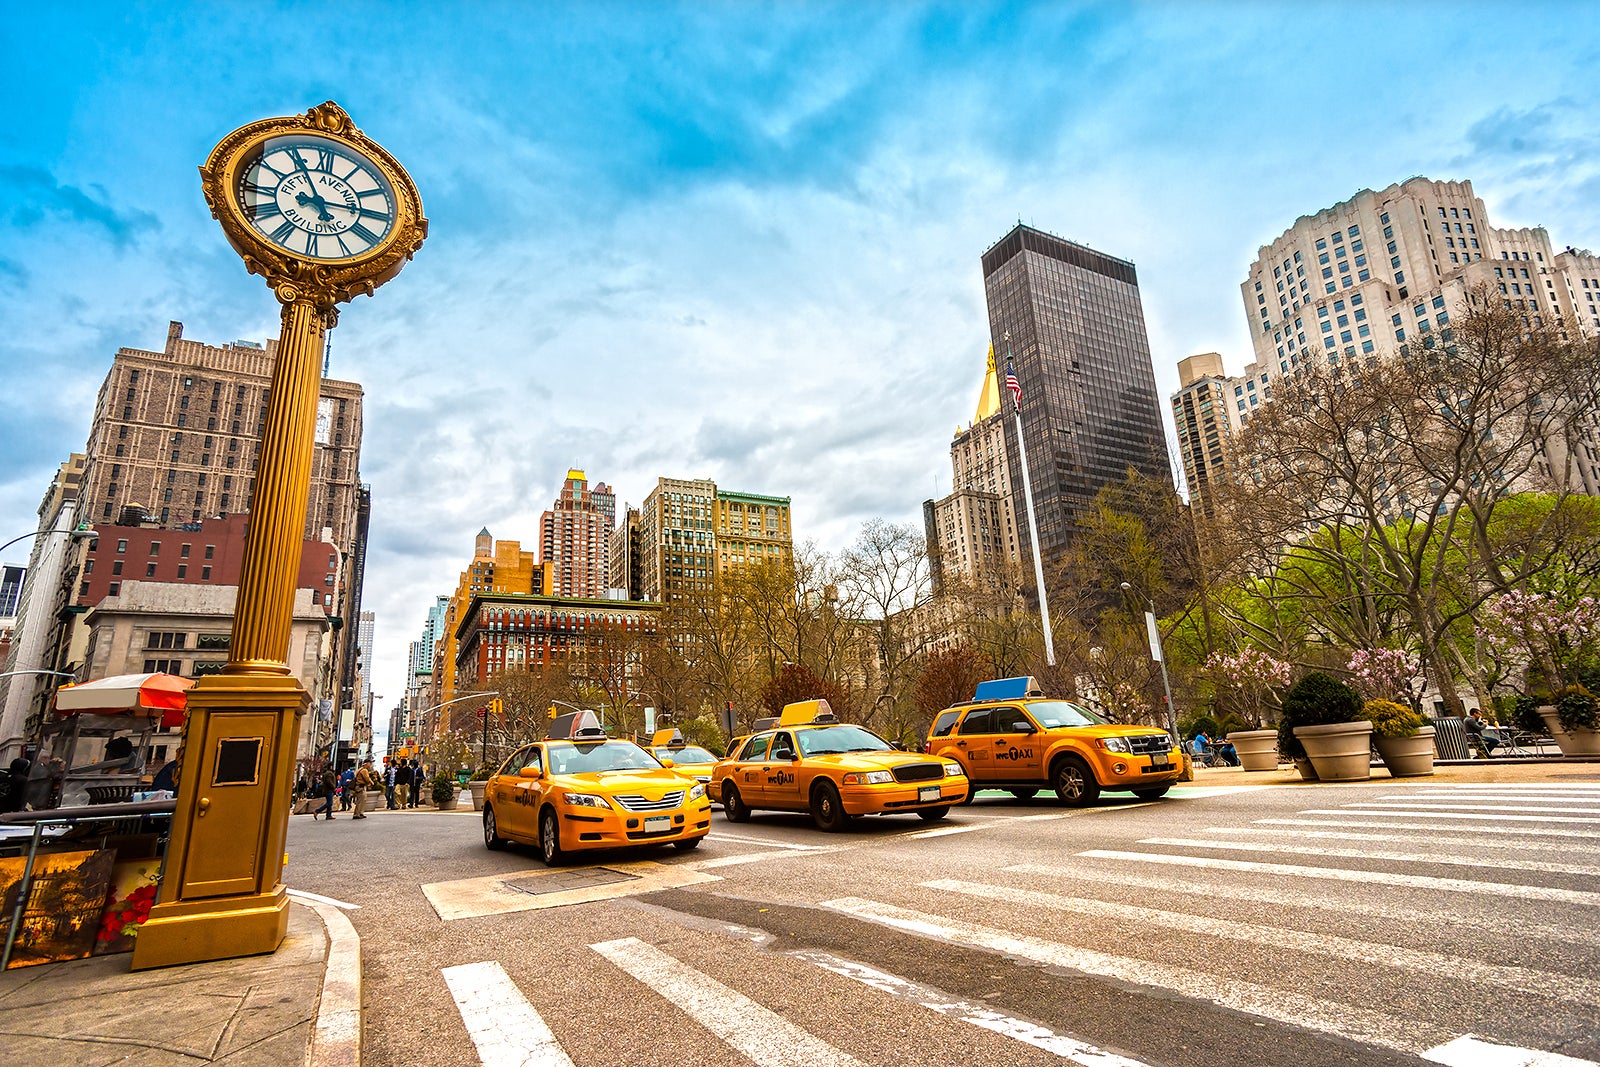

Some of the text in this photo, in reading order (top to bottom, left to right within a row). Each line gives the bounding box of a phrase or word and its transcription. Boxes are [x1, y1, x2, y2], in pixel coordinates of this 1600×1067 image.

[285, 209, 347, 233] BUILDING
[1009, 746, 1033, 761] TAXI
[777, 770, 795, 785] TAXI
